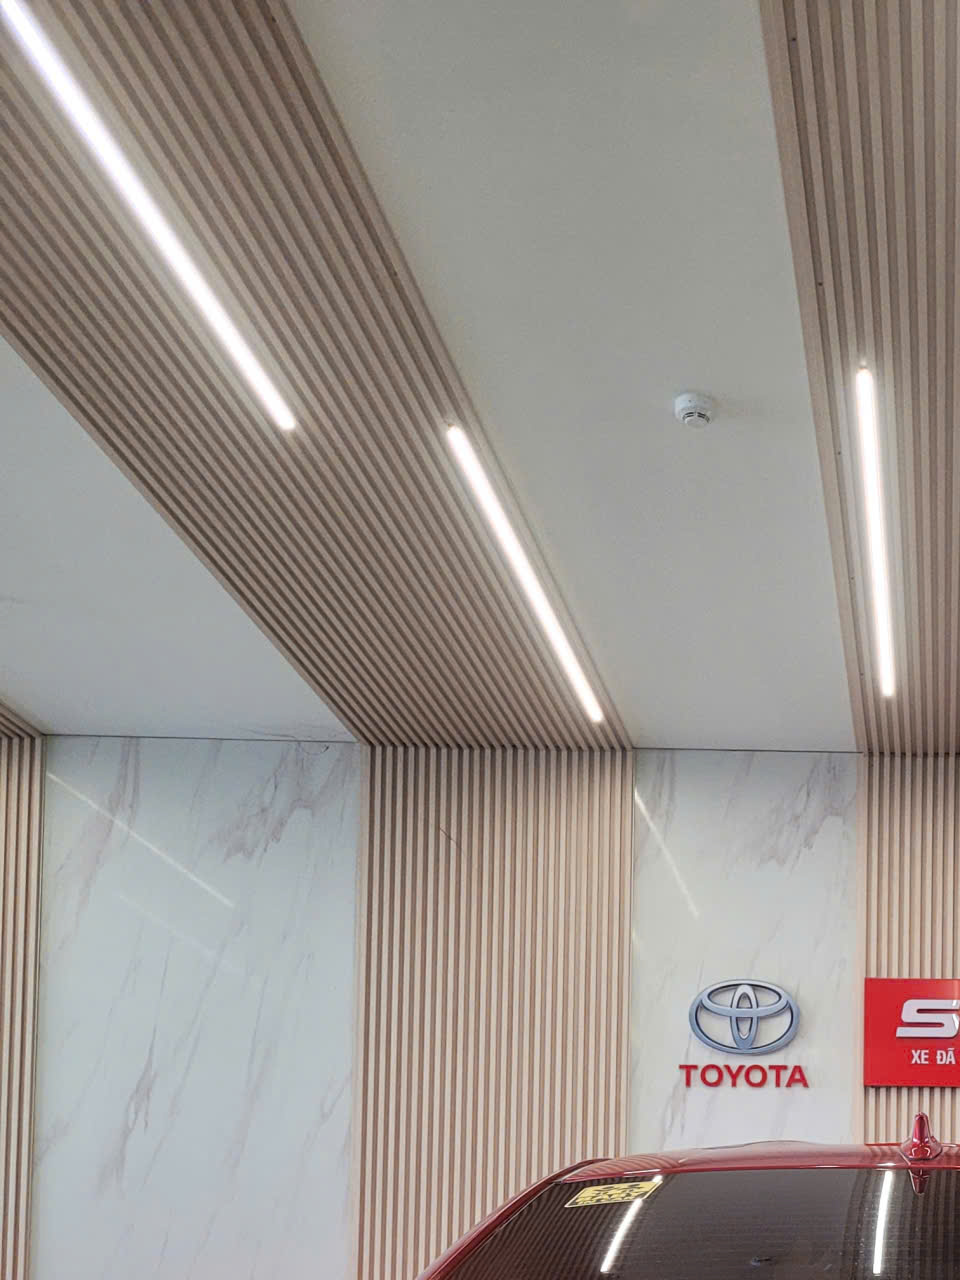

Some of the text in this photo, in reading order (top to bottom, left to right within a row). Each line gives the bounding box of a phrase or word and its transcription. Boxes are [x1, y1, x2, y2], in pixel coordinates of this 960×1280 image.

[911, 1049, 929, 1065] XE
[936, 1048, 956, 1065] ĐÃ
[678, 1064, 809, 1088] TOYOTA
